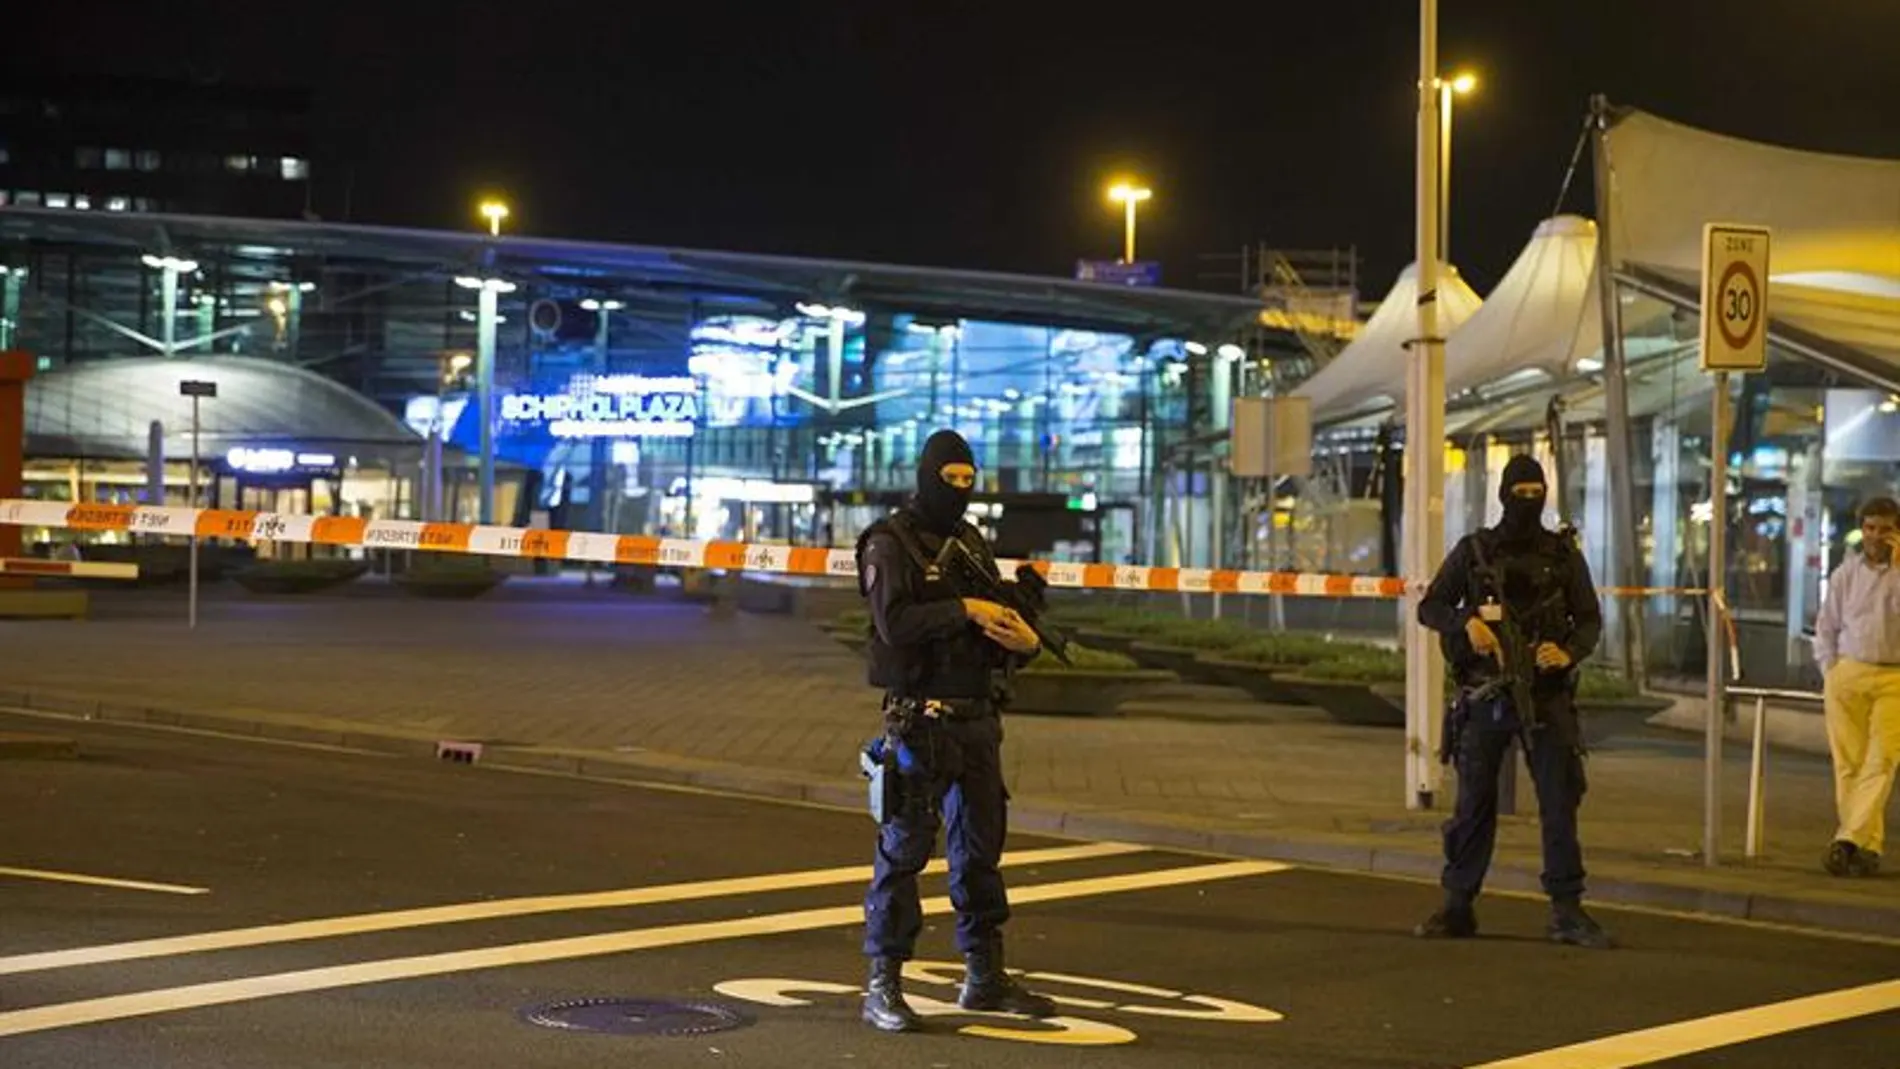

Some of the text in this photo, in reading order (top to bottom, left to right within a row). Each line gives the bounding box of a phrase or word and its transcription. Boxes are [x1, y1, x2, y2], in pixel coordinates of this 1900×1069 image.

[1725, 288, 1751, 321] 30
[502, 394, 698, 420] SCHIPHOL PLAZA
